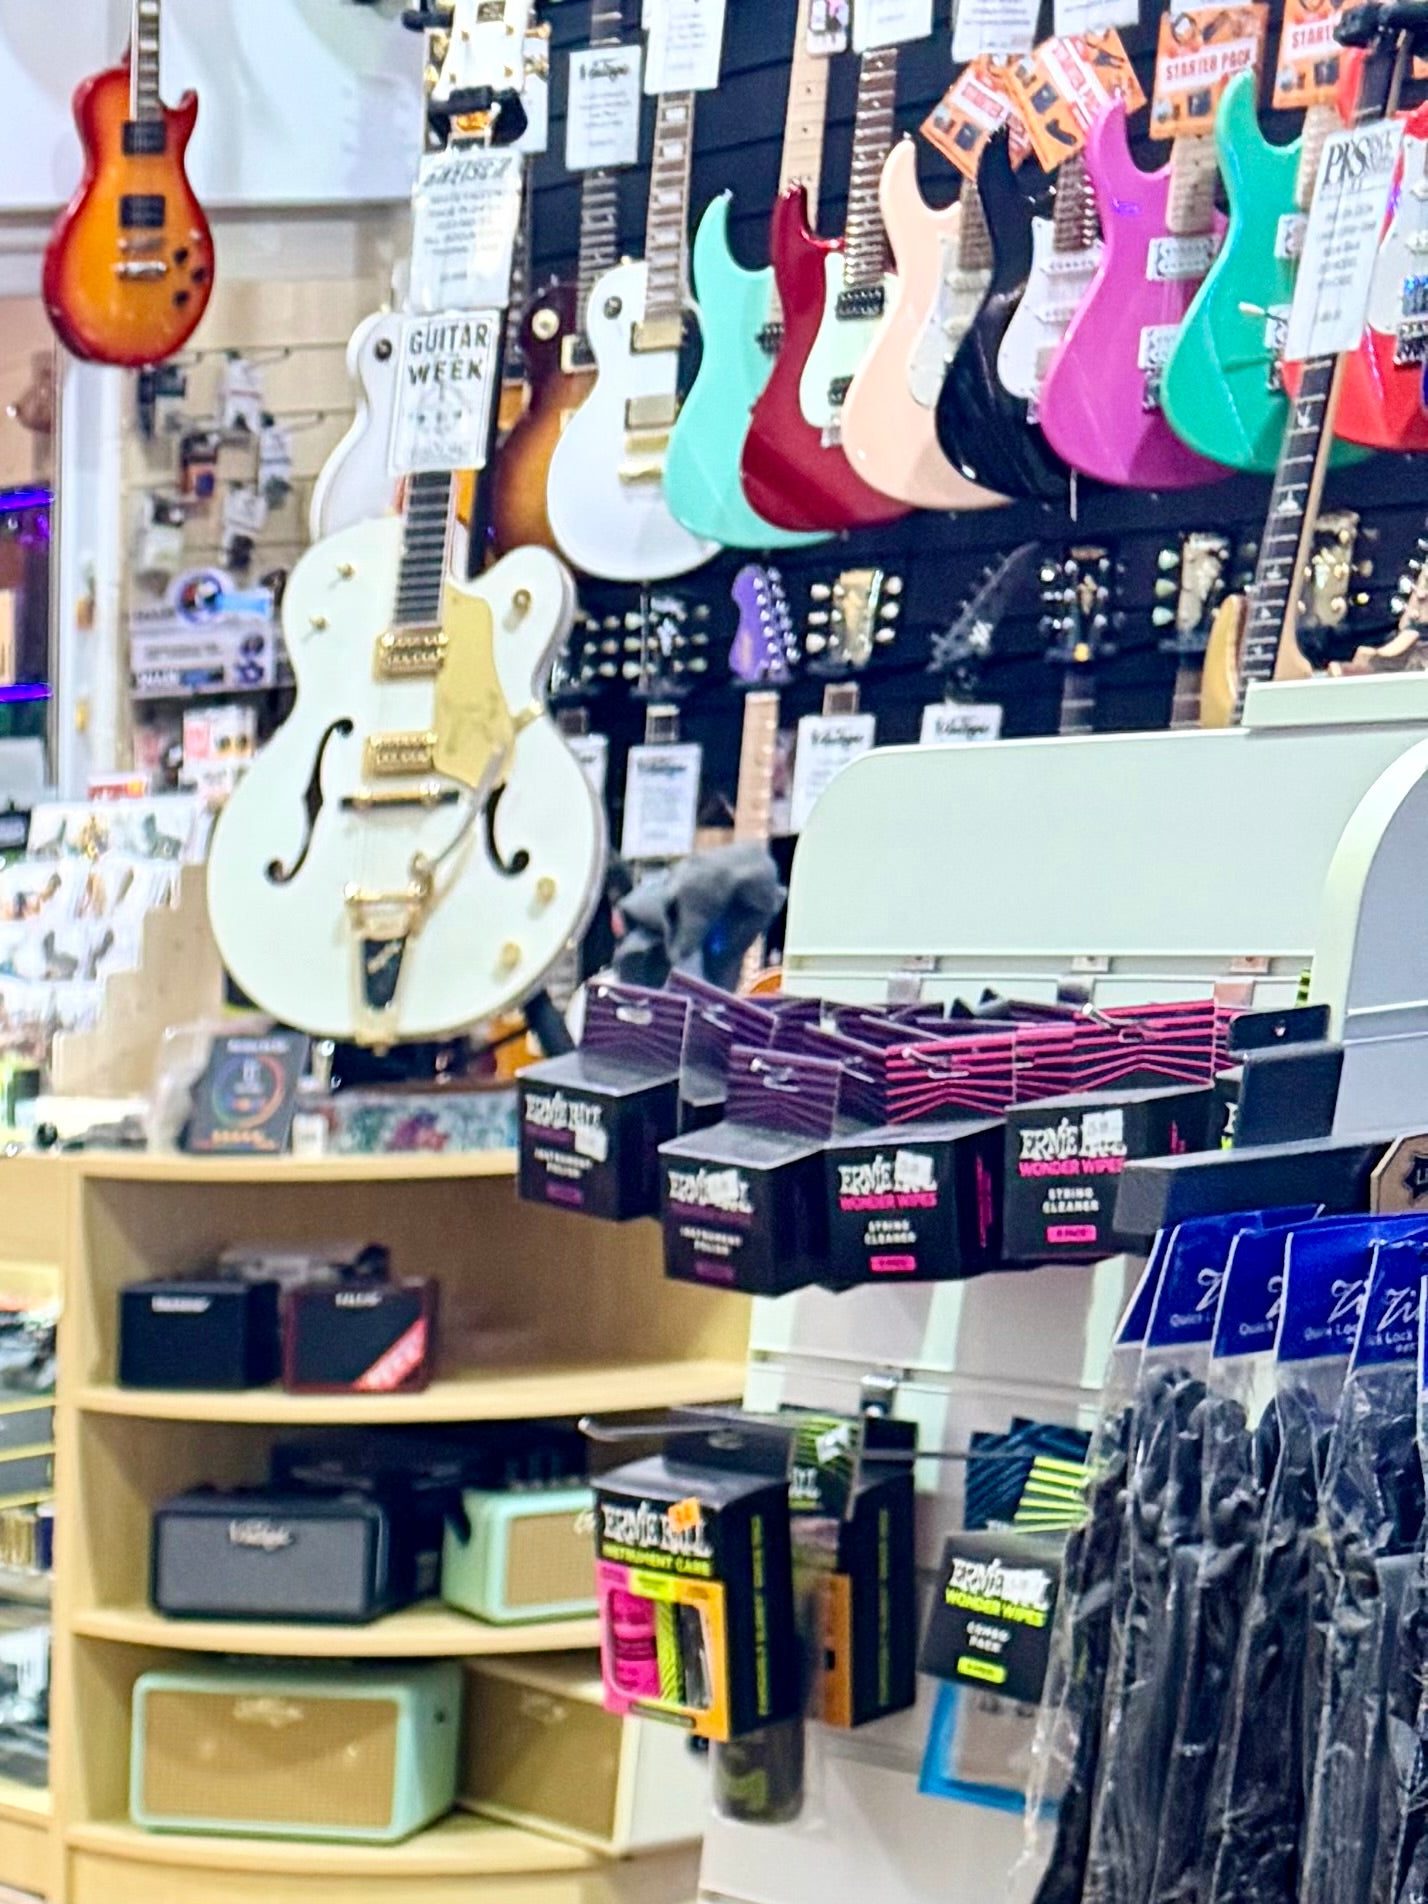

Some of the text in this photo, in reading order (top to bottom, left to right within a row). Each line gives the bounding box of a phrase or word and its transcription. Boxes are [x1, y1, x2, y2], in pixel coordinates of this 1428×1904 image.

[409, 322, 489, 355] GUITAR
[407, 357, 483, 386] WEEK
[1018, 1115, 1079, 1161] ERNIE
[837, 1153, 893, 1196] ERNIE
[1017, 1158, 1080, 1178] WONDER
[600, 1500, 660, 1550] ERNIE
